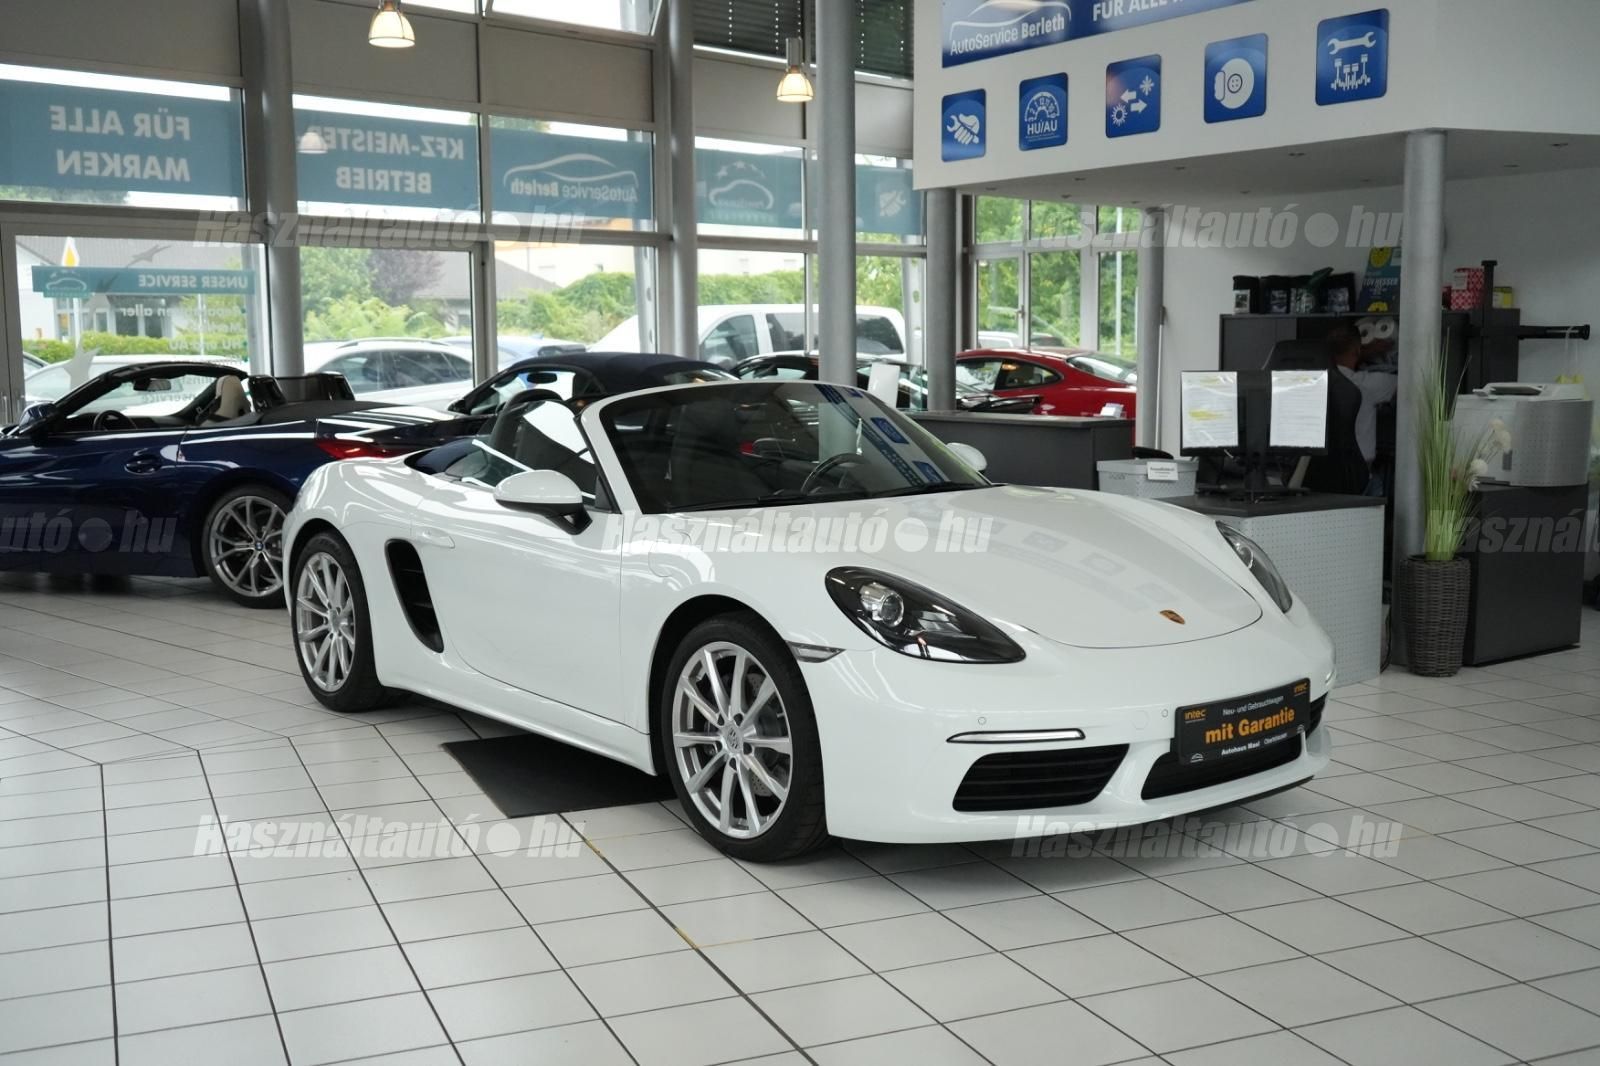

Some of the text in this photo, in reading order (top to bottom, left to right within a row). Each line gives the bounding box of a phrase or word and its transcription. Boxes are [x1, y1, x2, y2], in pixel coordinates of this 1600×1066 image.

[950, 13, 1065, 56] AutoService Berleth
[1027, 120, 1058, 135] HU/AU
[1205, 723, 1234, 744] mit
[1238, 706, 1296, 737] Garantie
